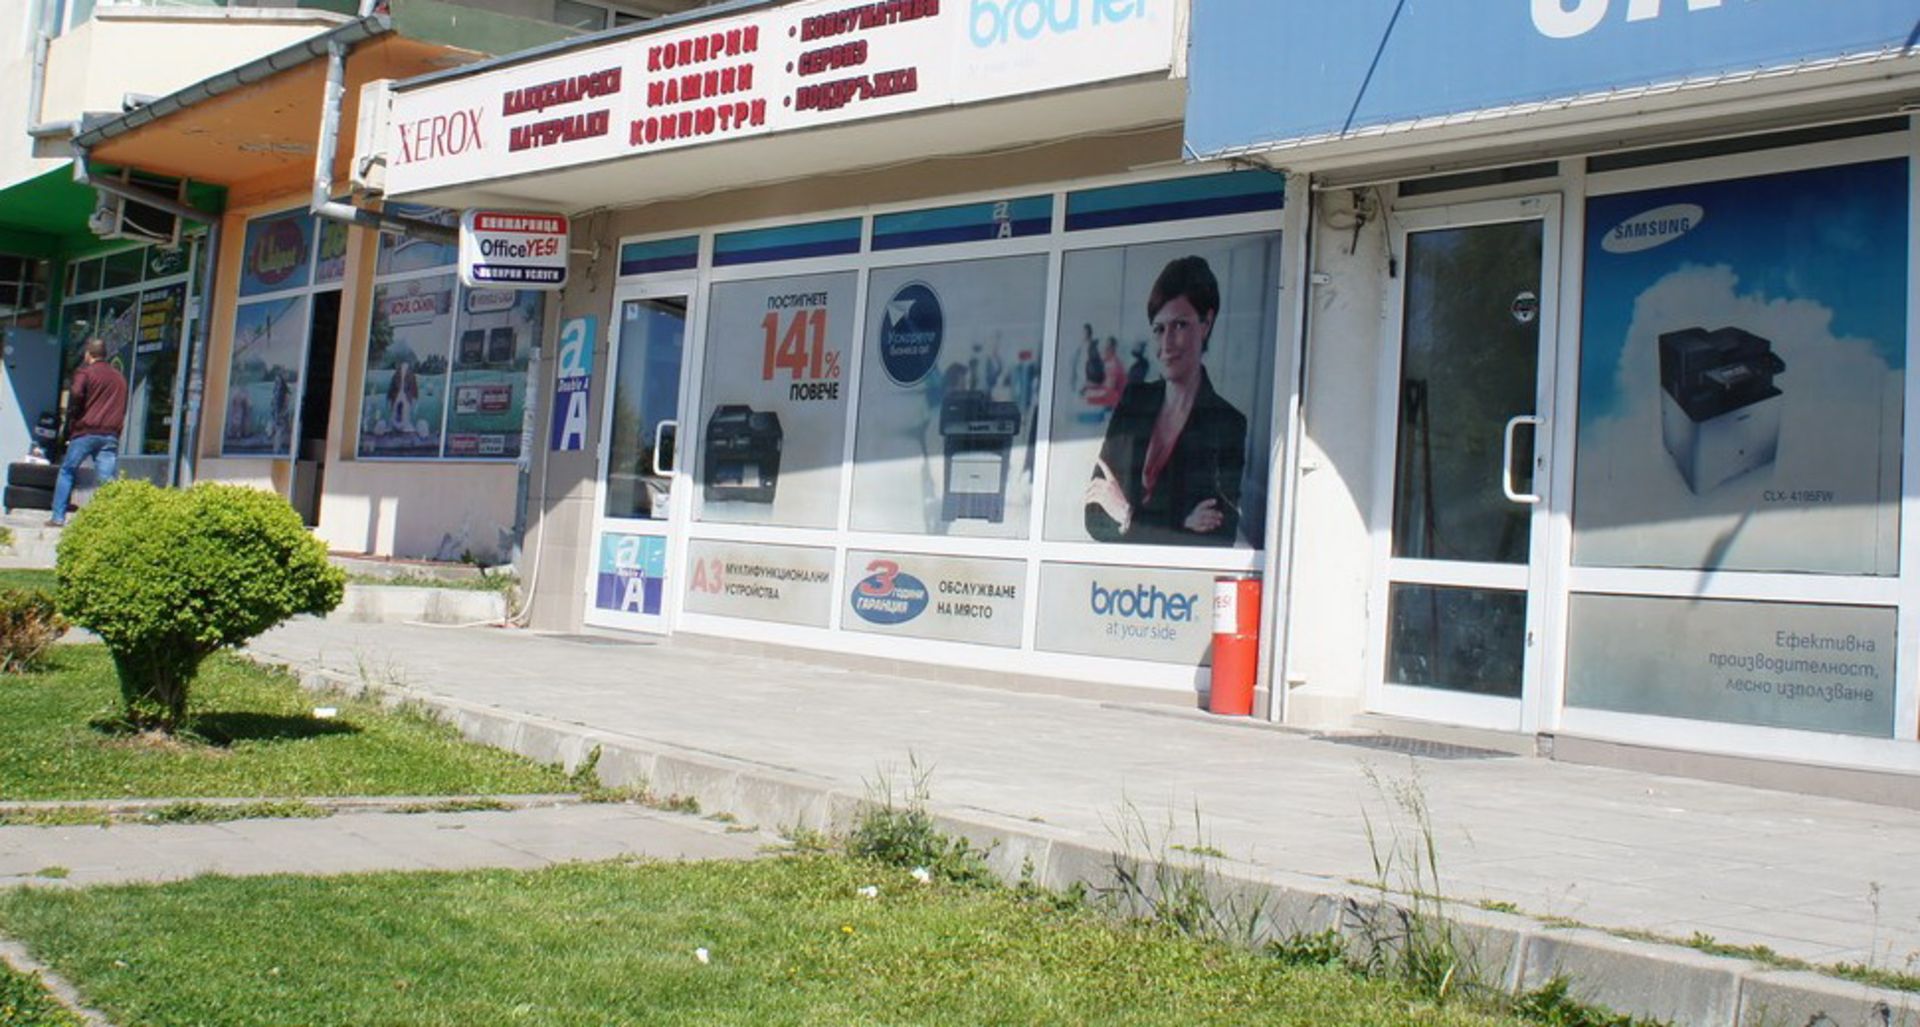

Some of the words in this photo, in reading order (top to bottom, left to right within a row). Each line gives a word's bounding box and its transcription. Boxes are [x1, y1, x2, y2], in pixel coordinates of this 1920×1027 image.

[647, 25, 759, 72] КОПИРНИ
[797, 39, 868, 77] СЕРВИЗ
[502, 66, 622, 117] КАНЦЕЛАРСКИ
[647, 63, 754, 108] МАШИНИ
[795, 67, 918, 111] ПОДДРЪЖКА
[508, 109, 611, 152] МАТЕРИАЛИ
[629, 98, 767, 146] КОМПЮТРИ
[395, 106, 485, 165] XEROX
[1614, 217, 1690, 240] SAMSUNG
[767, 292, 828, 309] ПОСТИГНЕТЕ
[789, 382, 839, 401] ПОВЕЧЕ
[725, 563, 830, 583] МУЛТИФУНКЦИОНАЛНИ
[858, 559, 900, 597] 3
[725, 583, 780, 599] УСТРОЙСТВА
[938, 581, 1016, 599] ОБСЛУЖВАНЕ
[1091, 580, 1199, 622] brother
[855, 597, 909, 615] ГАРАНЦИЯ
[937, 602, 952, 616] НА
[953, 602, 993, 619] МЯСТО
[1106, 621, 1118, 635] at
[1121, 623, 1149, 639] your
[1150, 623, 1177, 640] side
[1775, 630, 1877, 653] Ефективна
[1725, 678, 1772, 694] лесно
[1776, 681, 1874, 702] използване
